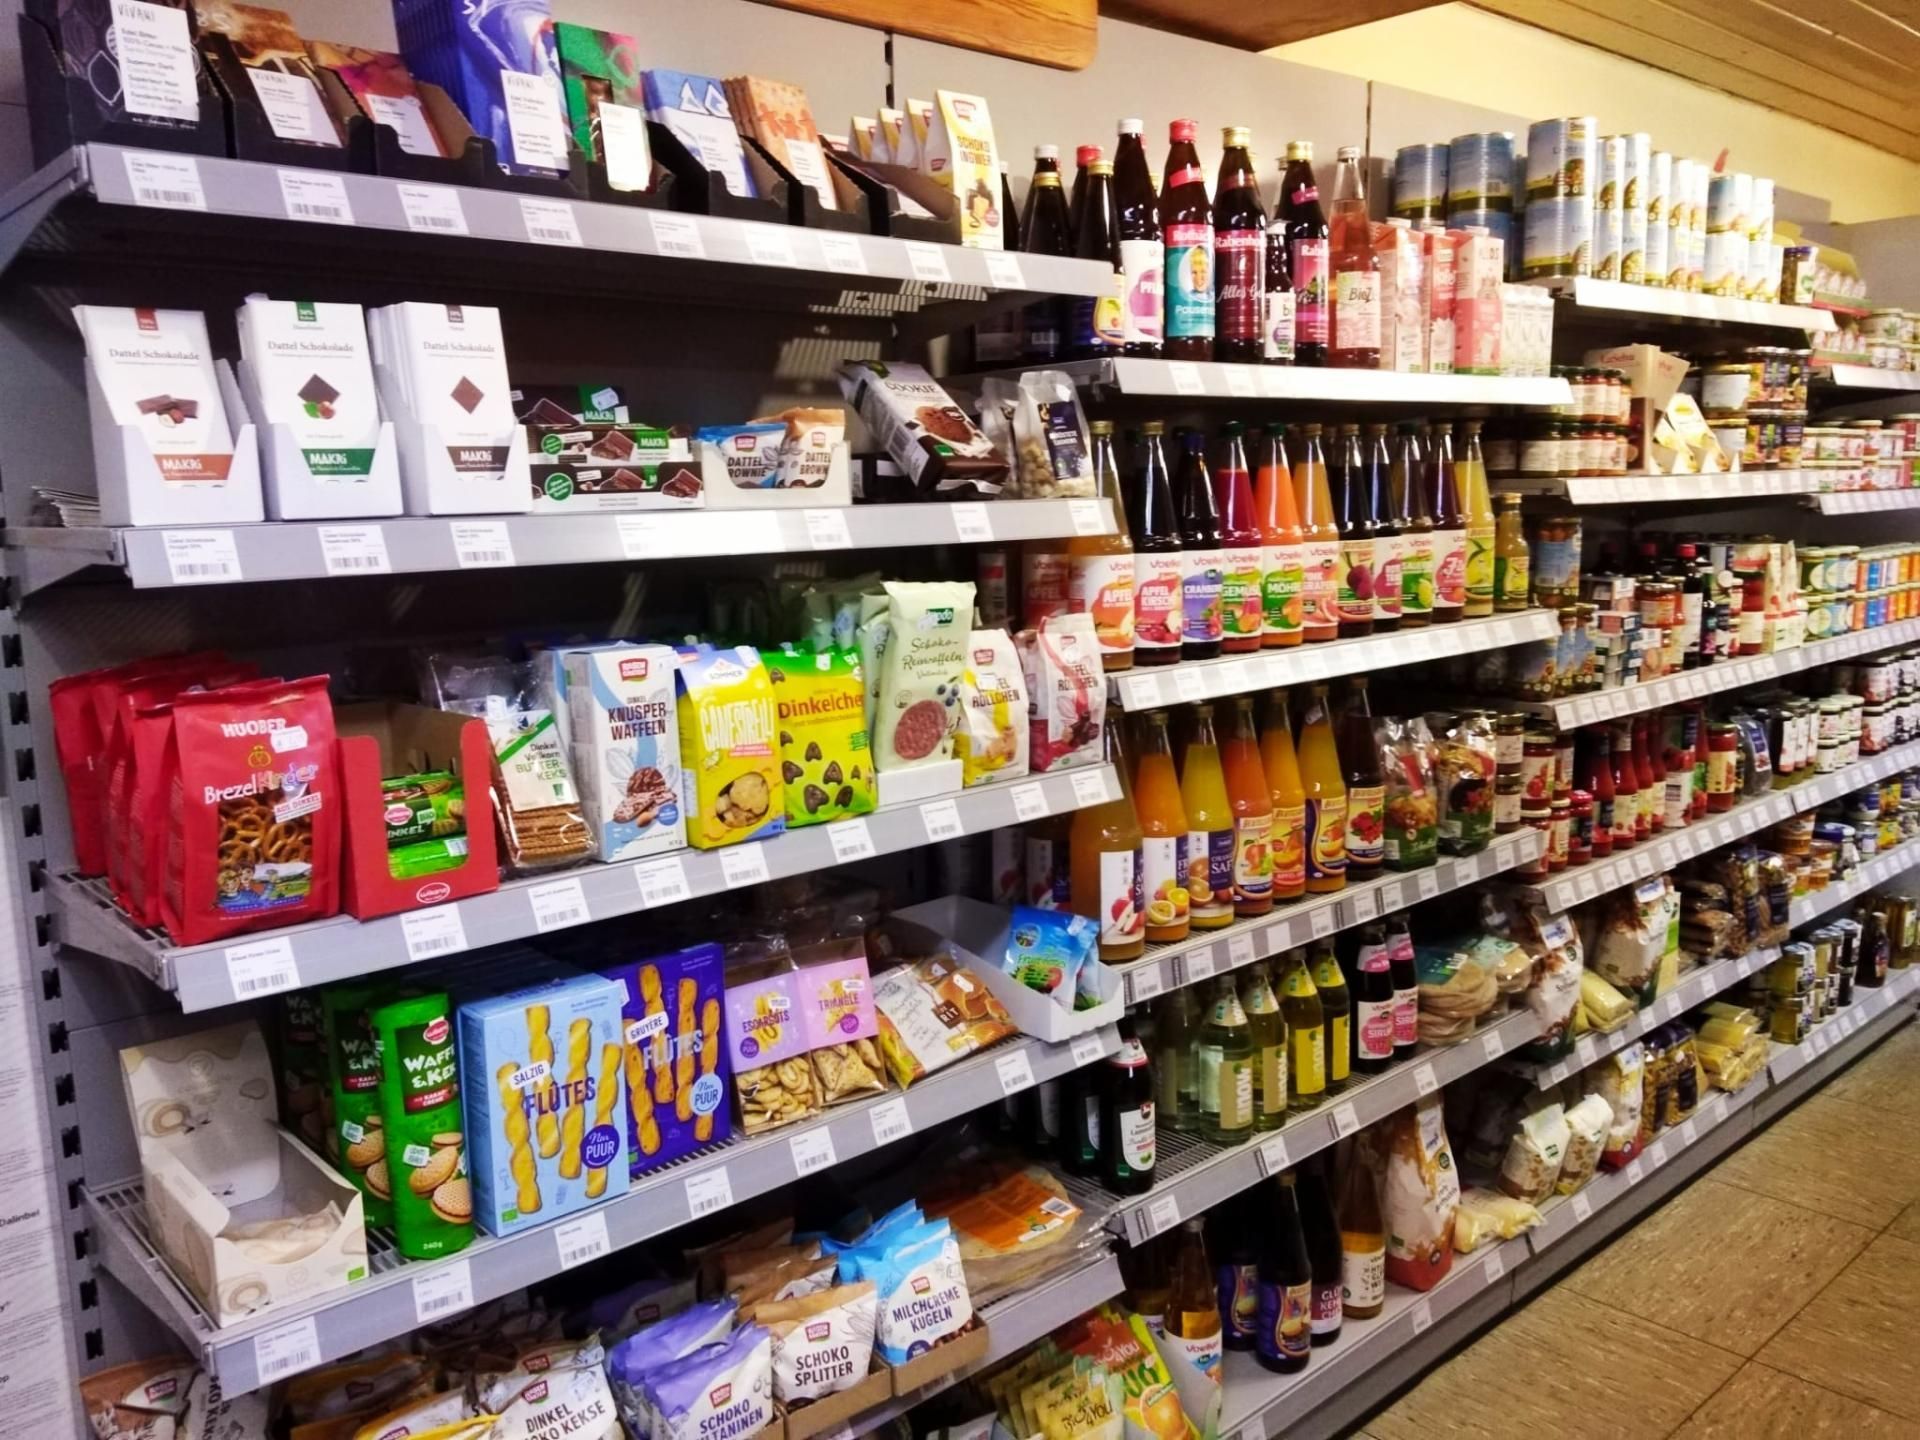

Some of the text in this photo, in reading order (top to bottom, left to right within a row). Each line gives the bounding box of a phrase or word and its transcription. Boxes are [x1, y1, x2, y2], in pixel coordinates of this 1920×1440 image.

[108, 348, 201, 361] Dattel Schokolade
[267, 340, 354, 353] Dattel Schokolade
[423, 340, 496, 353] Dattel Schokolade
[727, 456, 764, 468] DATTEL
[728, 467, 767, 478] ROWNIE
[799, 464, 828, 475] BROWN
[607, 702, 667, 724] KNUSPER
[220, 717, 288, 738] HUOBER
[610, 719, 666, 741] WAFFELN
[537, 769, 567, 781] KEKS
[387, 825, 425, 838] INKEL
[513, 1064, 545, 1086] SALZIG
[694, 1088, 719, 1106] PUUR
[585, 1139, 616, 1159] PUUR
[892, 1286, 961, 1323] MILCHCREME
[909, 1305, 953, 1334] KUGELN
[795, 1345, 850, 1372] SCHOKO
[794, 1361, 853, 1388] SPLITTER
[525, 1403, 573, 1434] DINKEL
[560, 1400, 606, 1435] KEKSE
[699, 1398, 751, 1434] SCHOKO
